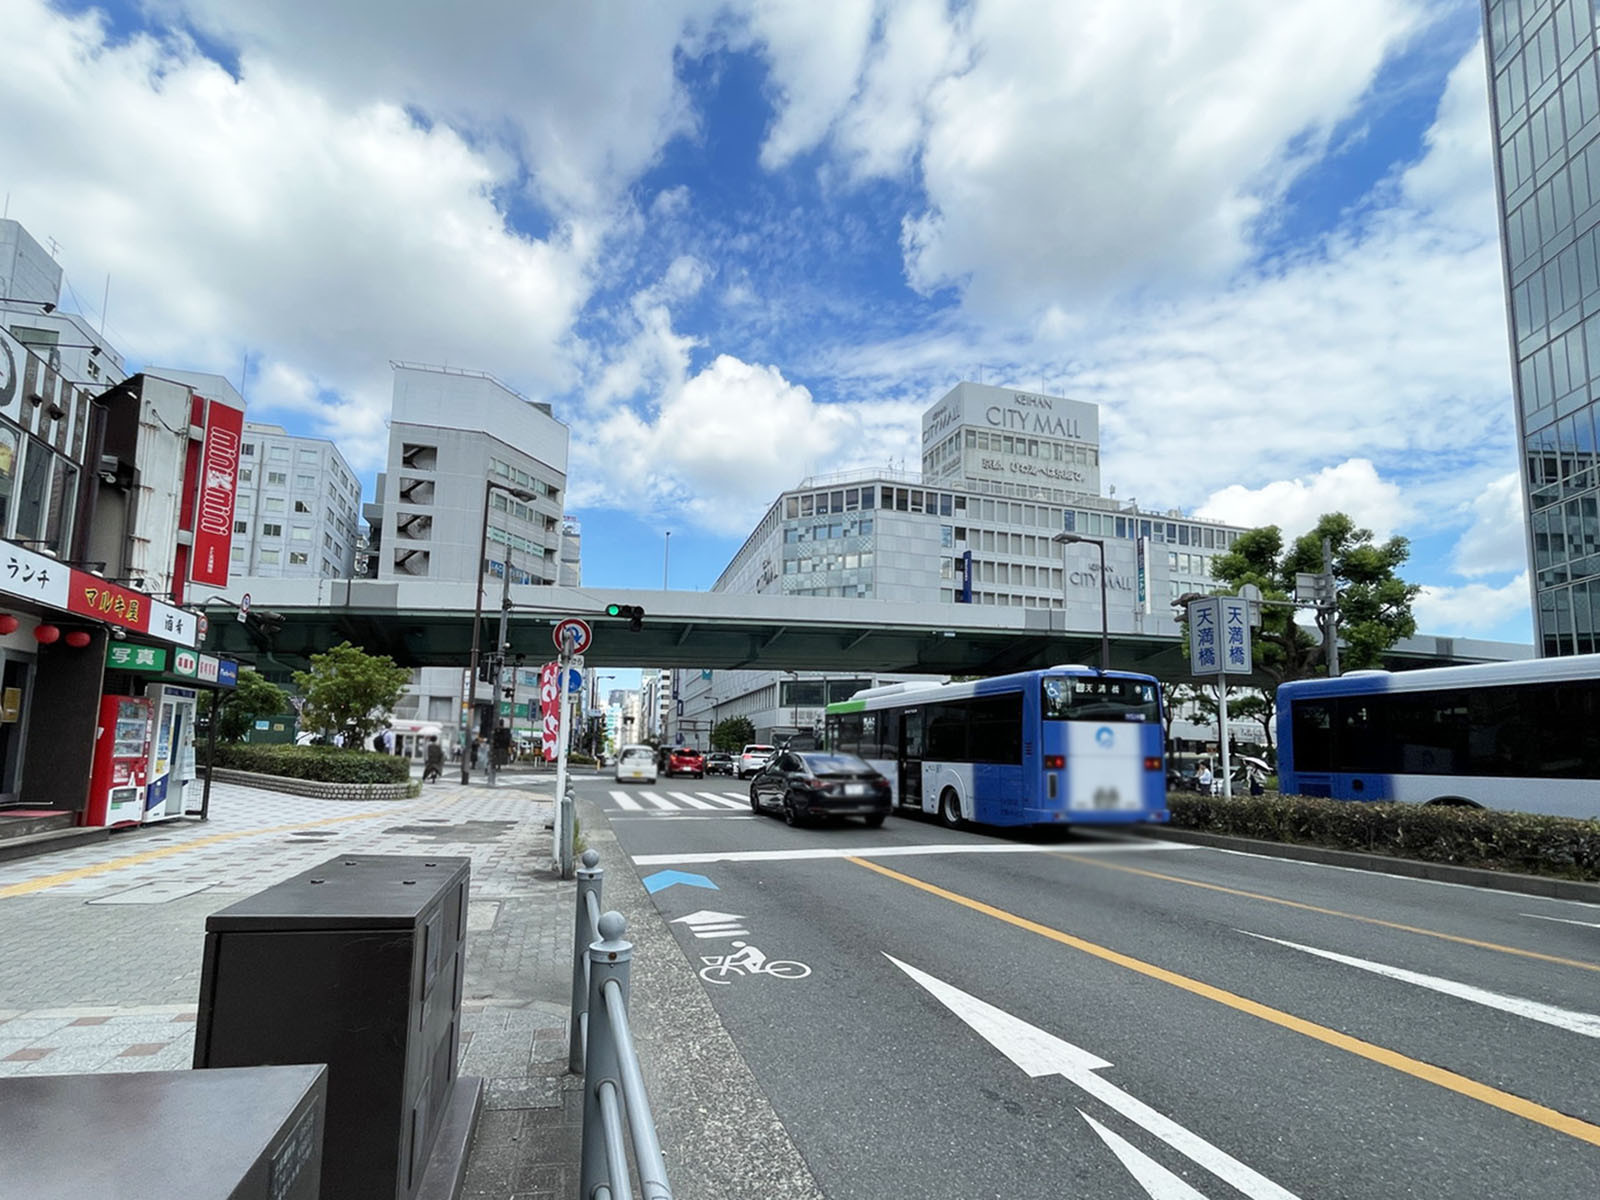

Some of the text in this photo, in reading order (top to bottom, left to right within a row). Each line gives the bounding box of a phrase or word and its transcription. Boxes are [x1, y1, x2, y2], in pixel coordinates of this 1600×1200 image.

[1014, 393, 1053, 410] KEIHAN
[986, 406, 1081, 439] CITY MALL
[6, 557, 51, 590] ランチ
[1069, 571, 1097, 586] CITY
[84, 587, 141, 624] マルキ屋
[1196, 607, 1216, 667] 天満橋
[1227, 606, 1245, 665] 天満橋
[111, 647, 155, 666] 写真
